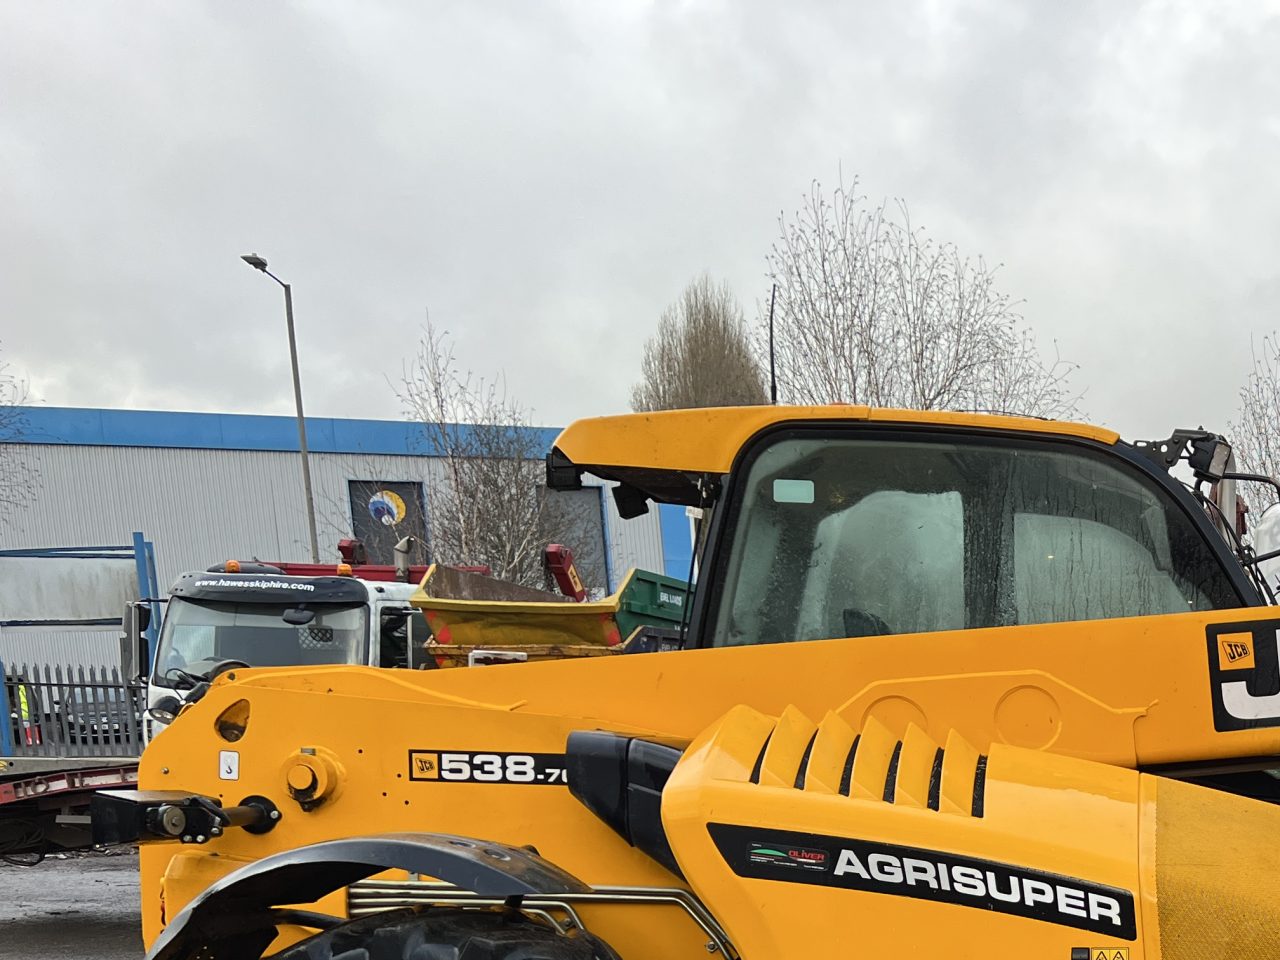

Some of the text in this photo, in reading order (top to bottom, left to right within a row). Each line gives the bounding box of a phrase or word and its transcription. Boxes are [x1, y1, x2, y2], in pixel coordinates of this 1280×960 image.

[195, 578, 314, 592] www.hawesskiphire.com
[1227, 641, 1249, 660] JCB
[417, 759, 435, 772] JCB
[834, 849, 1122, 926] AGRISUPER
